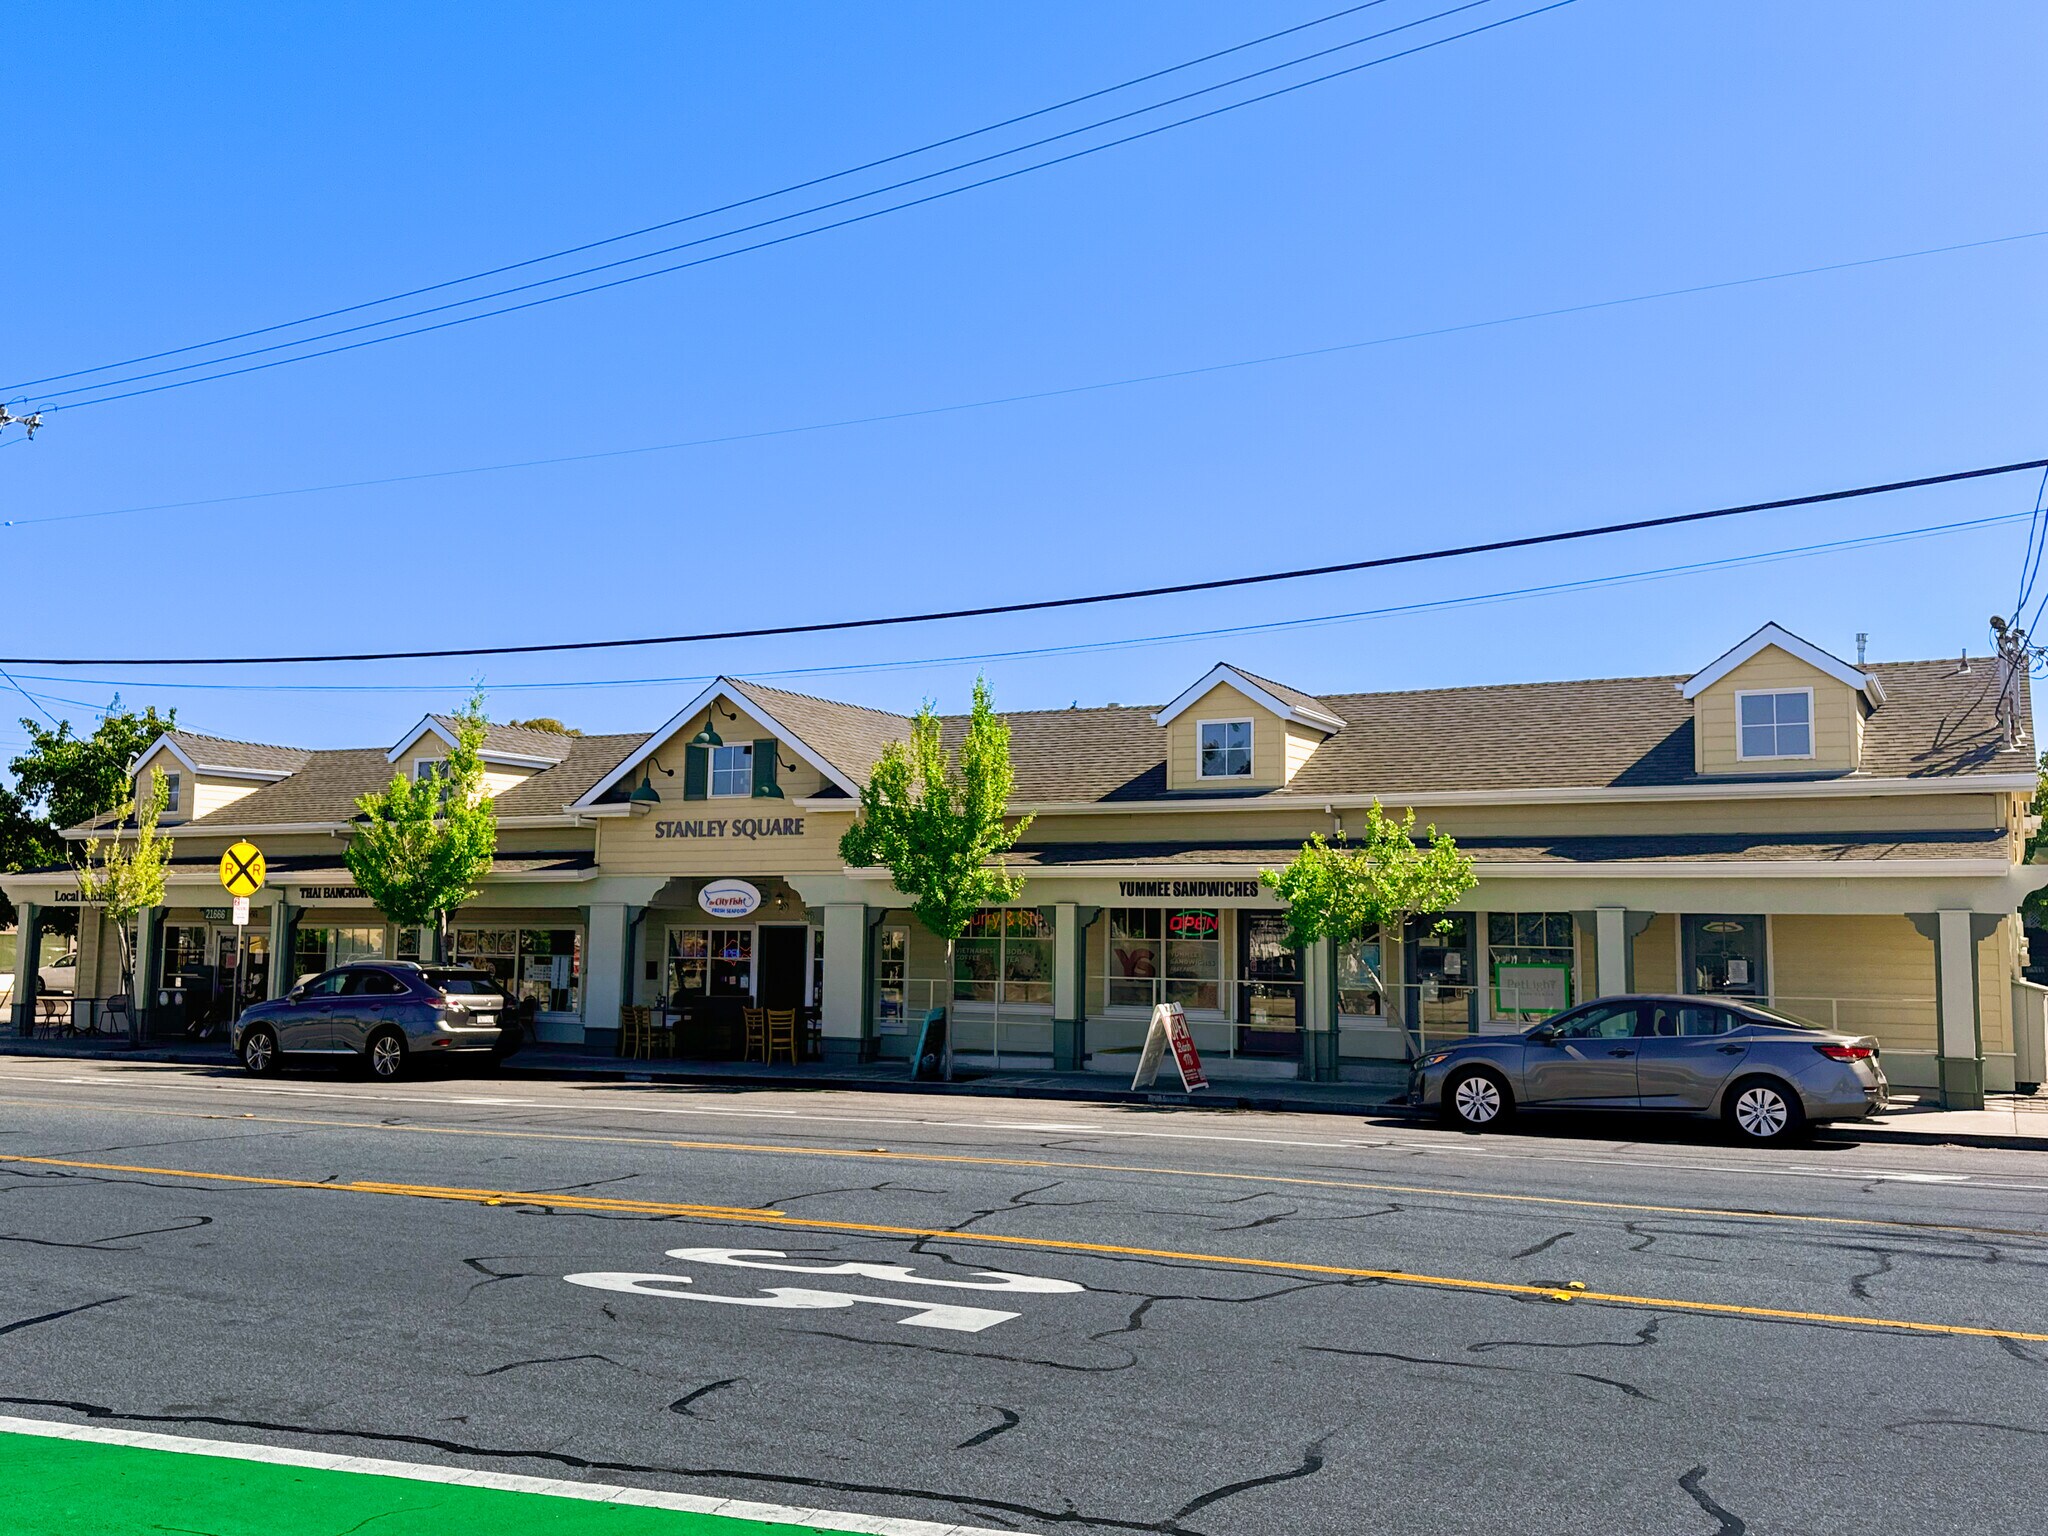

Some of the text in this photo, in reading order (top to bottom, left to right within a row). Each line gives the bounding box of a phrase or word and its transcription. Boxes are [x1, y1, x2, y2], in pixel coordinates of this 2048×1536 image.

[655, 818, 804, 840] STANLEY SQUARE
[225, 862, 234, 875] R
[252, 864, 261, 876] R
[54, 890, 79, 902] Local
[299, 887, 322, 898] THAI
[1119, 881, 1259, 897] YUMMEE SANDWICHES
[715, 898, 729, 906] City
[729, 897, 743, 905] Fish
[971, 911, 1001, 930] urry
[1169, 916, 1219, 931] OPEN
[1169, 1014, 1190, 1041] OPEN
